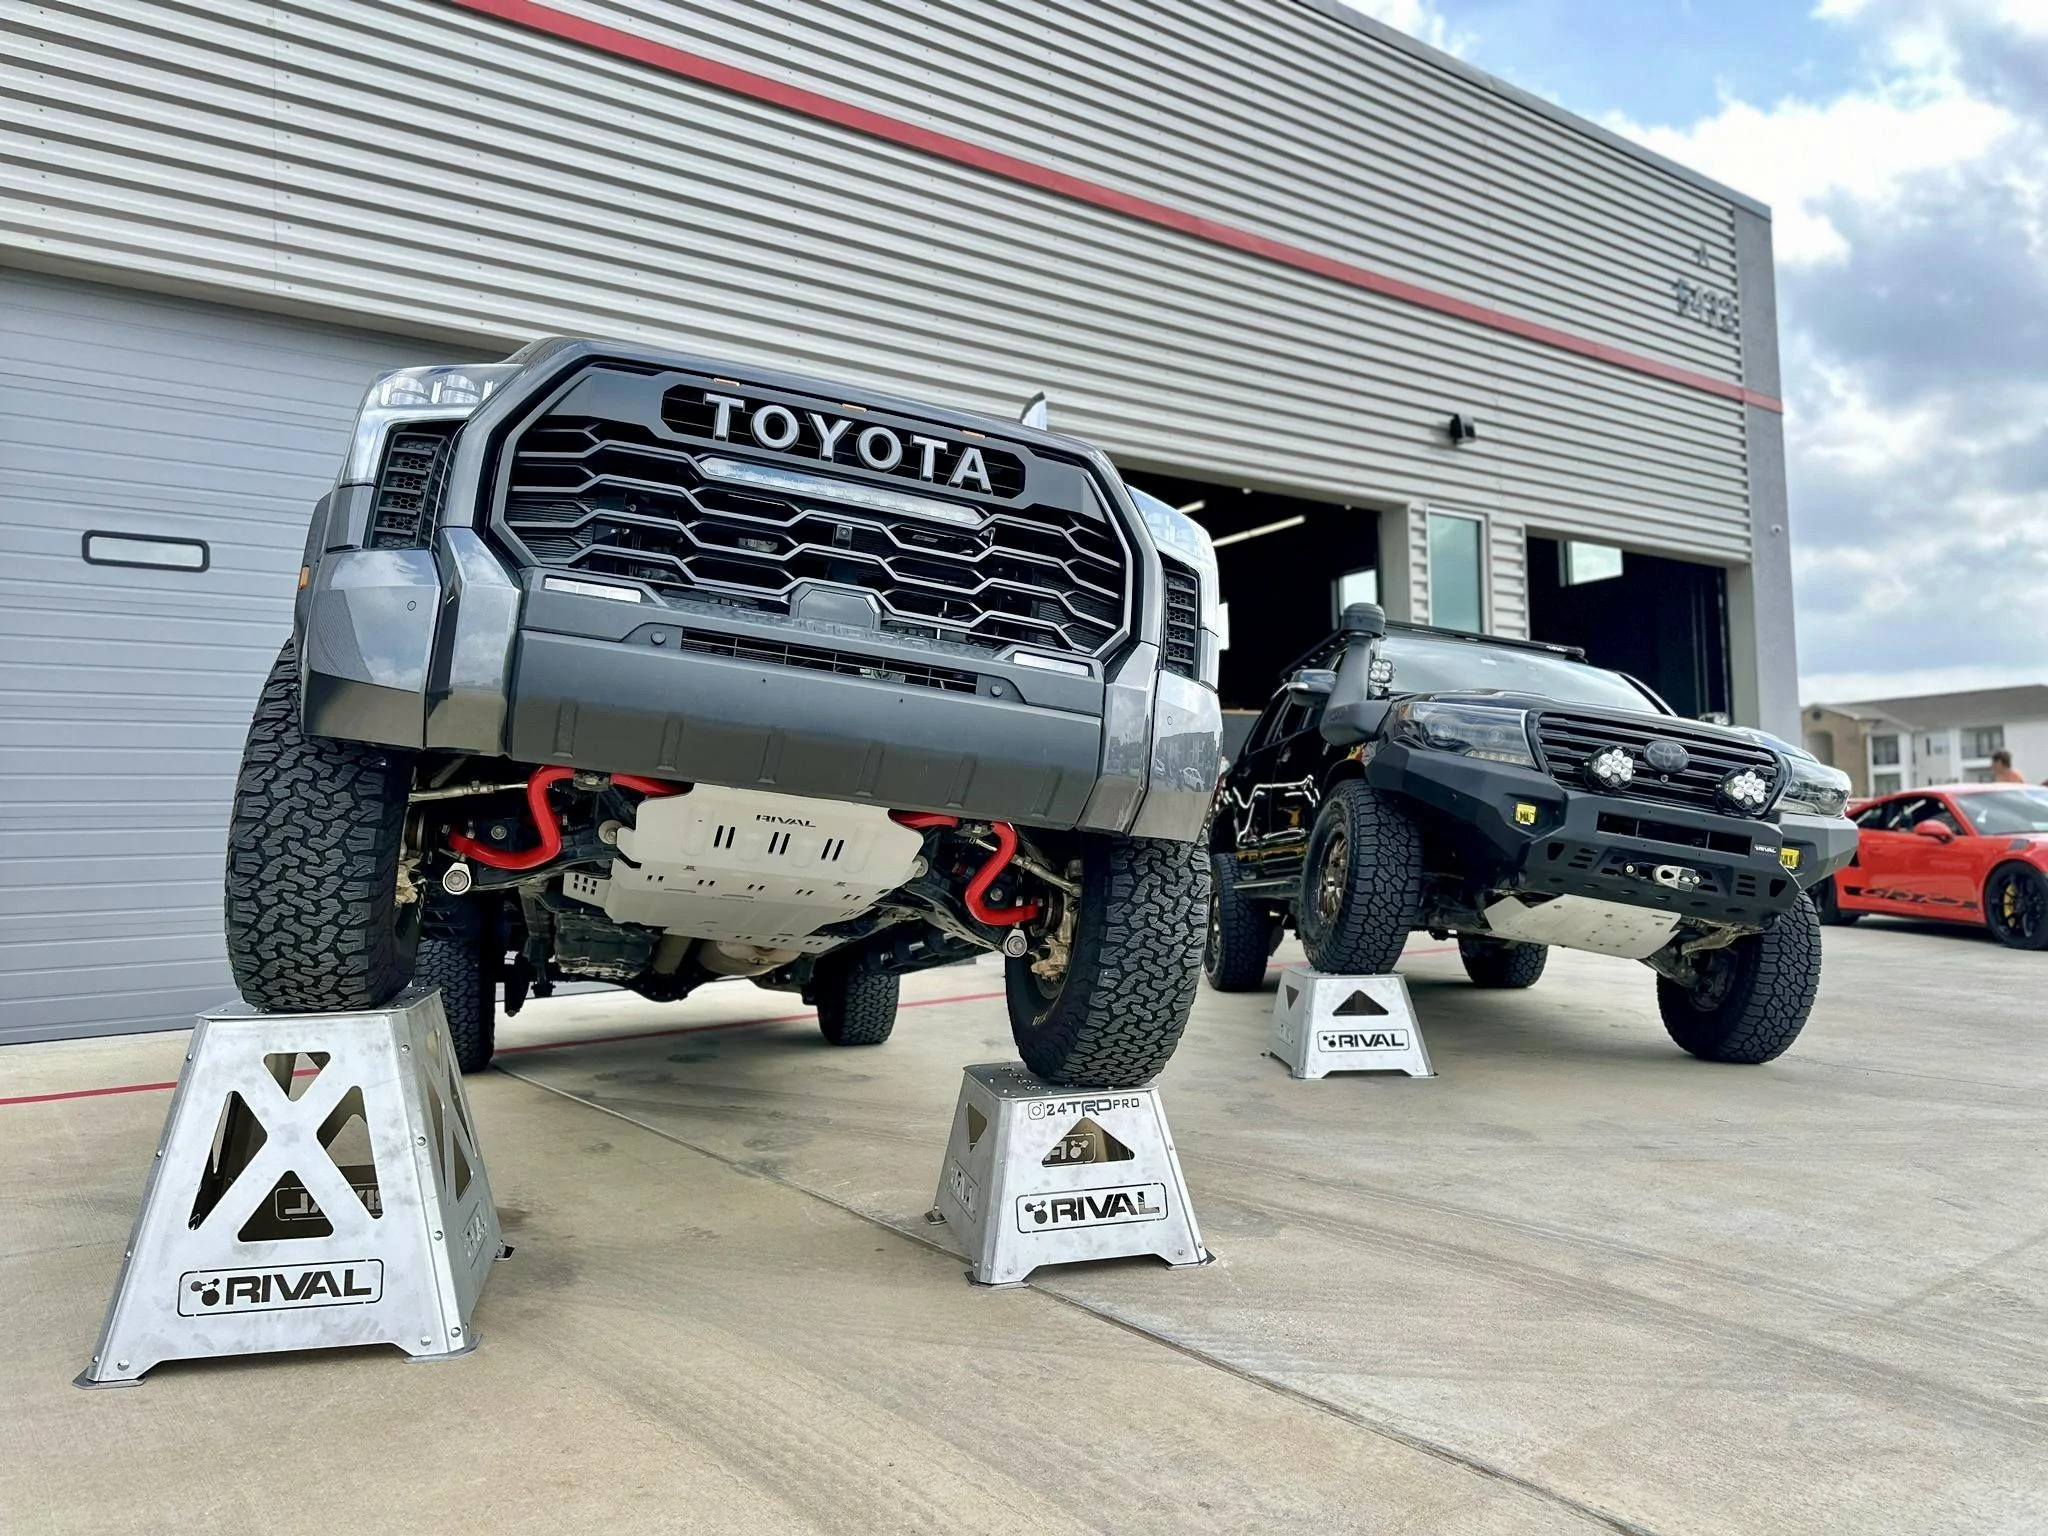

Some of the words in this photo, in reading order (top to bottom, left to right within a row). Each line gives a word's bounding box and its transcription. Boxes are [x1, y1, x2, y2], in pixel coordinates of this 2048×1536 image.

[703, 392, 994, 495] TOYOTA
[755, 814, 817, 828] RIVAL
[1338, 1033, 1405, 1048] RIVAL
[1050, 1191, 1161, 1224] RIVAL
[224, 1268, 373, 1306] RIVAL
